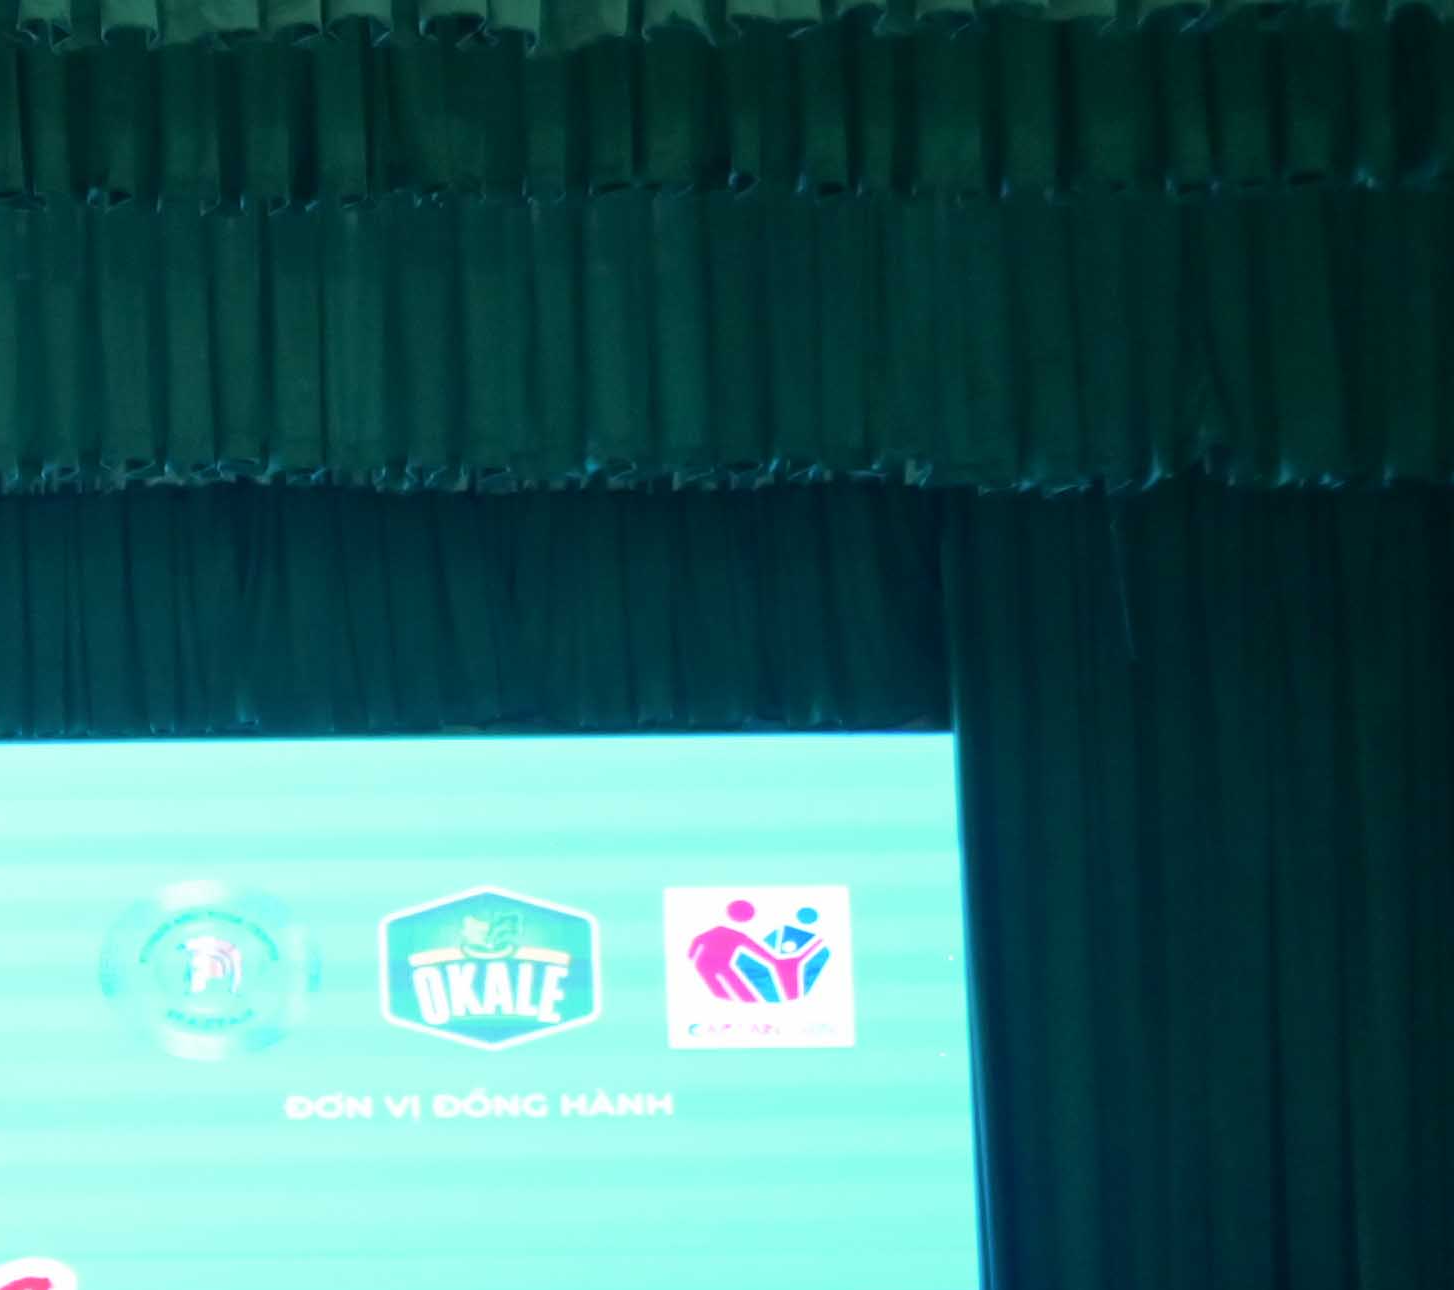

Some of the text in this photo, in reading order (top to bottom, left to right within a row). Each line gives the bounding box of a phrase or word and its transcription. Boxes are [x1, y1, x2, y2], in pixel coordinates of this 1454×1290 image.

[412, 961, 570, 1024] OKALE
[283, 1092, 373, 1121] ĐƠN
[383, 1093, 423, 1126] VỊ
